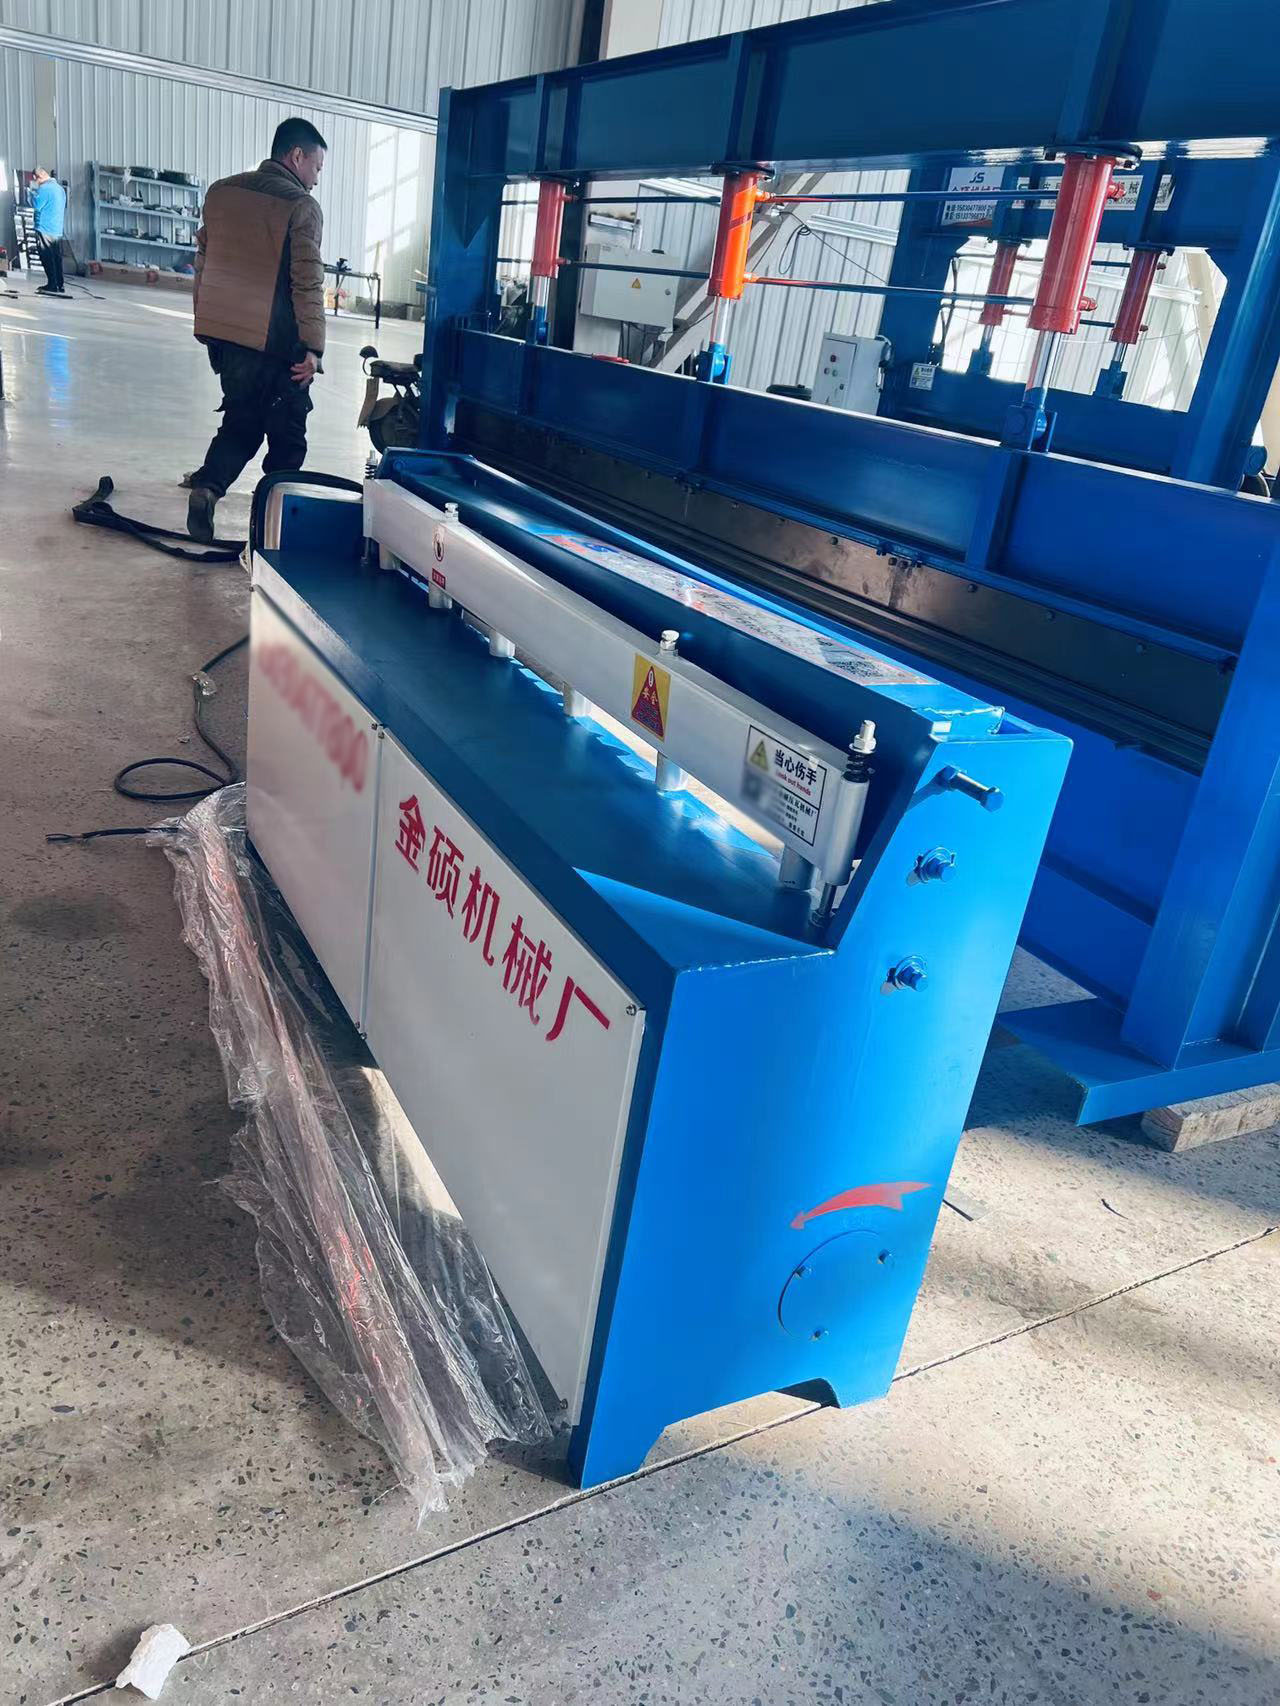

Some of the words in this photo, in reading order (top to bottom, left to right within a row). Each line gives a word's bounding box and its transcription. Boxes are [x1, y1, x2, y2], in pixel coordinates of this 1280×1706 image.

[775, 749, 817, 786] 当心伤手
[394, 794, 611, 1042] 金硕机械厂
